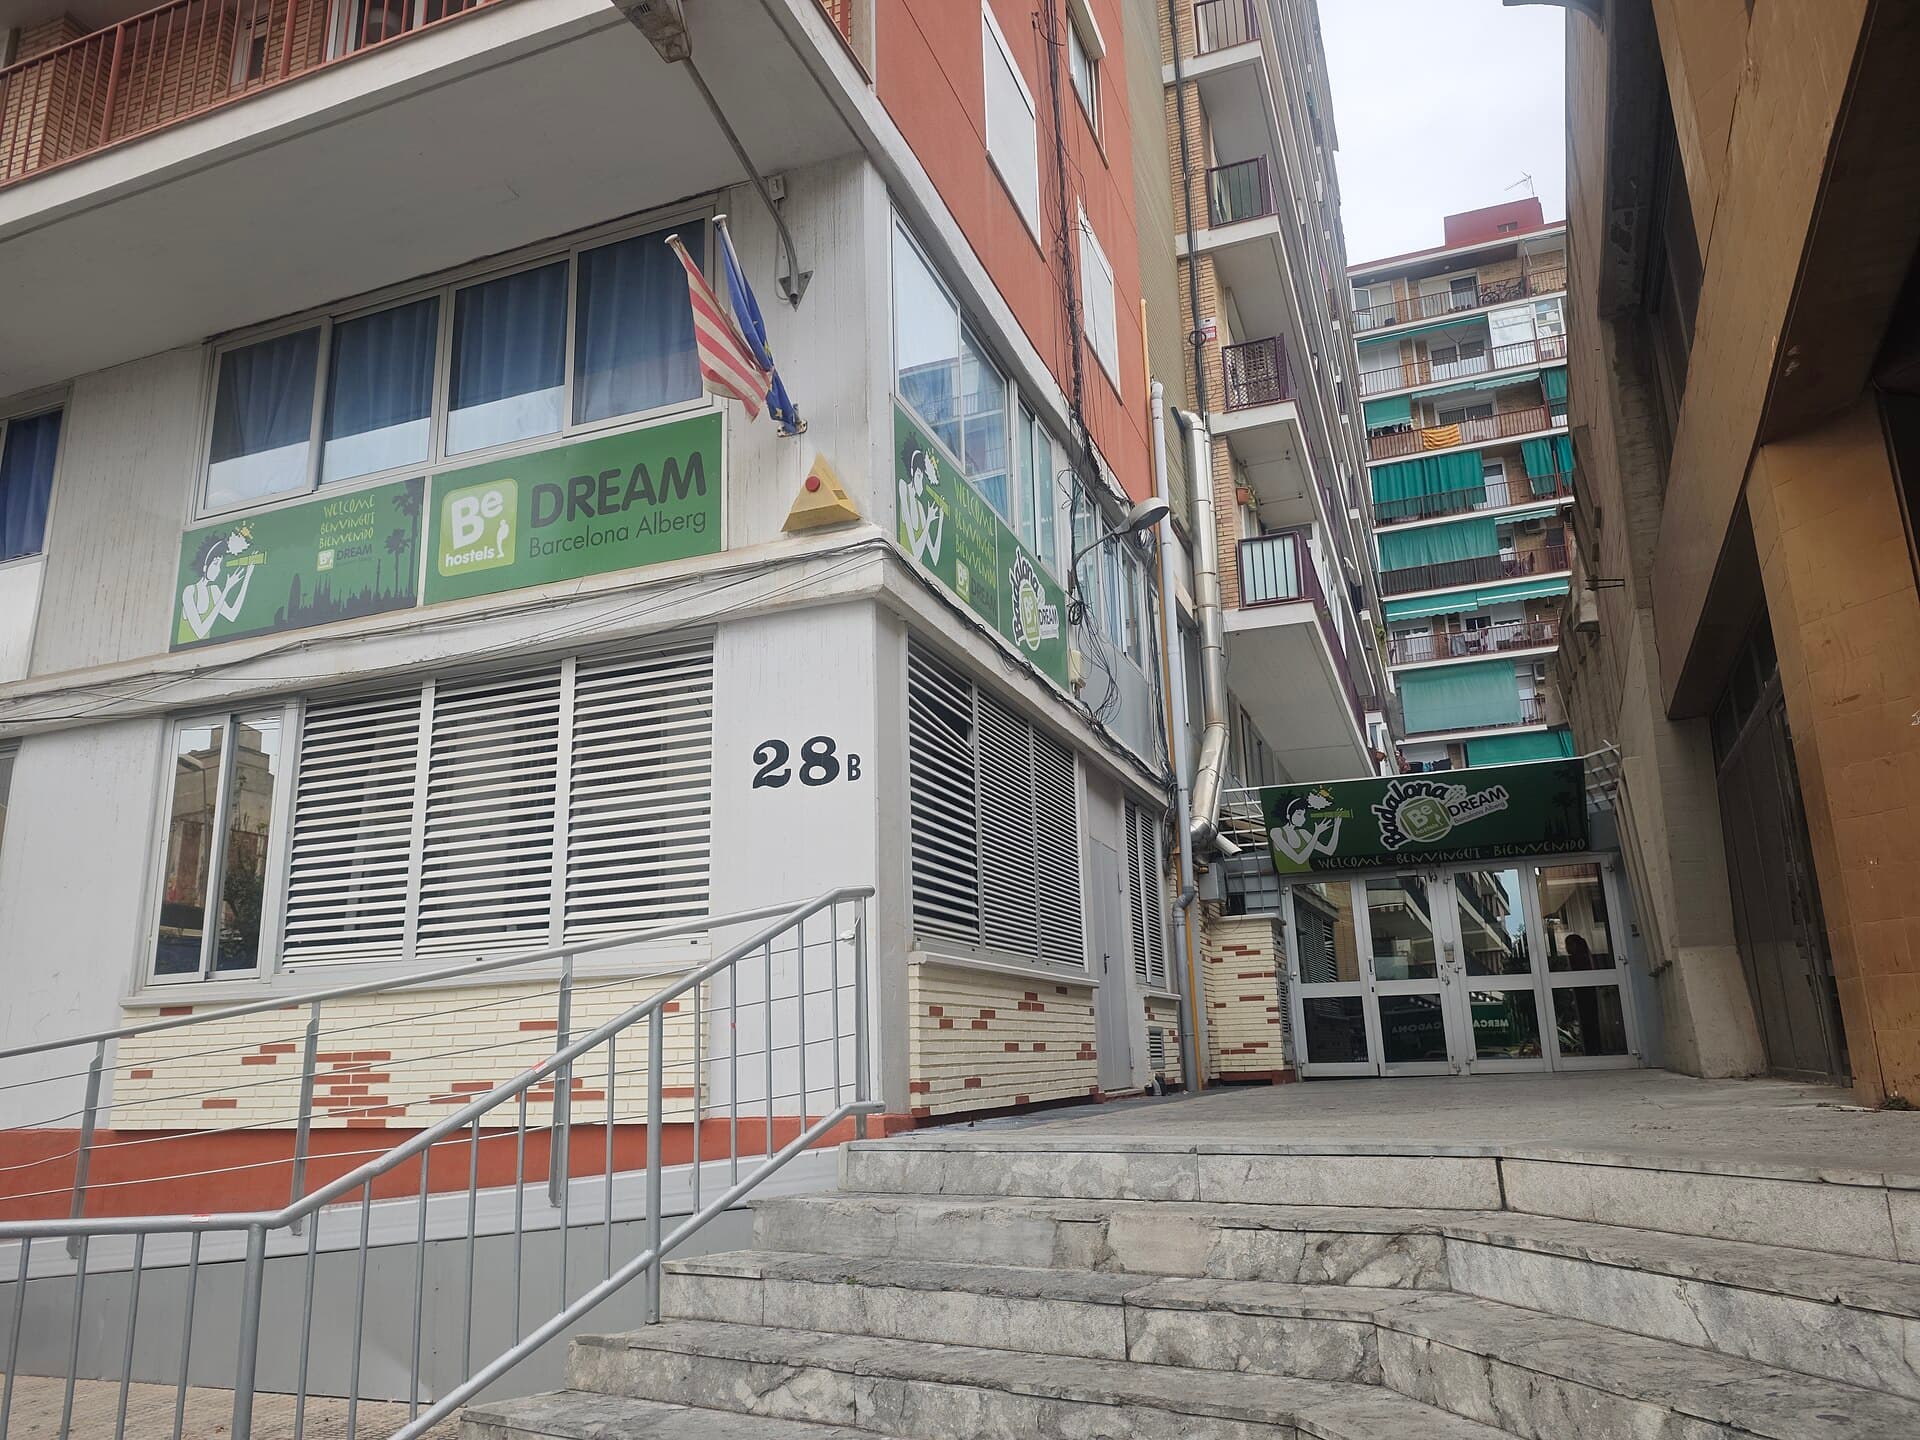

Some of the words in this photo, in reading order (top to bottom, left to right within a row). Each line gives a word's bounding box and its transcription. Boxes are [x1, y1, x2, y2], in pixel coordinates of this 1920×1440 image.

[323, 494, 375, 518] WELCOME
[531, 451, 707, 529] DREAM
[320, 511, 375, 535] BENVINGUT
[451, 490, 503, 550] Be
[953, 477, 994, 537] WELCOME
[529, 525, 629, 558] Barcelona
[635, 511, 706, 539] Alberg
[336, 543, 373, 560] DREAM
[445, 546, 495, 567] hostels
[1009, 547, 1039, 641] Badalona
[1022, 592, 1034, 625] Be
[1039, 604, 1058, 626] DREAM
[1373, 782, 1450, 848] Badalona
[1407, 803, 1433, 829] Be
[1448, 786, 1507, 817] DREAM
[1318, 856, 1384, 870] WELCOME
[1396, 846, 1482, 865] BENVINGUT
[1494, 838, 1586, 857] BIENVENIDO
